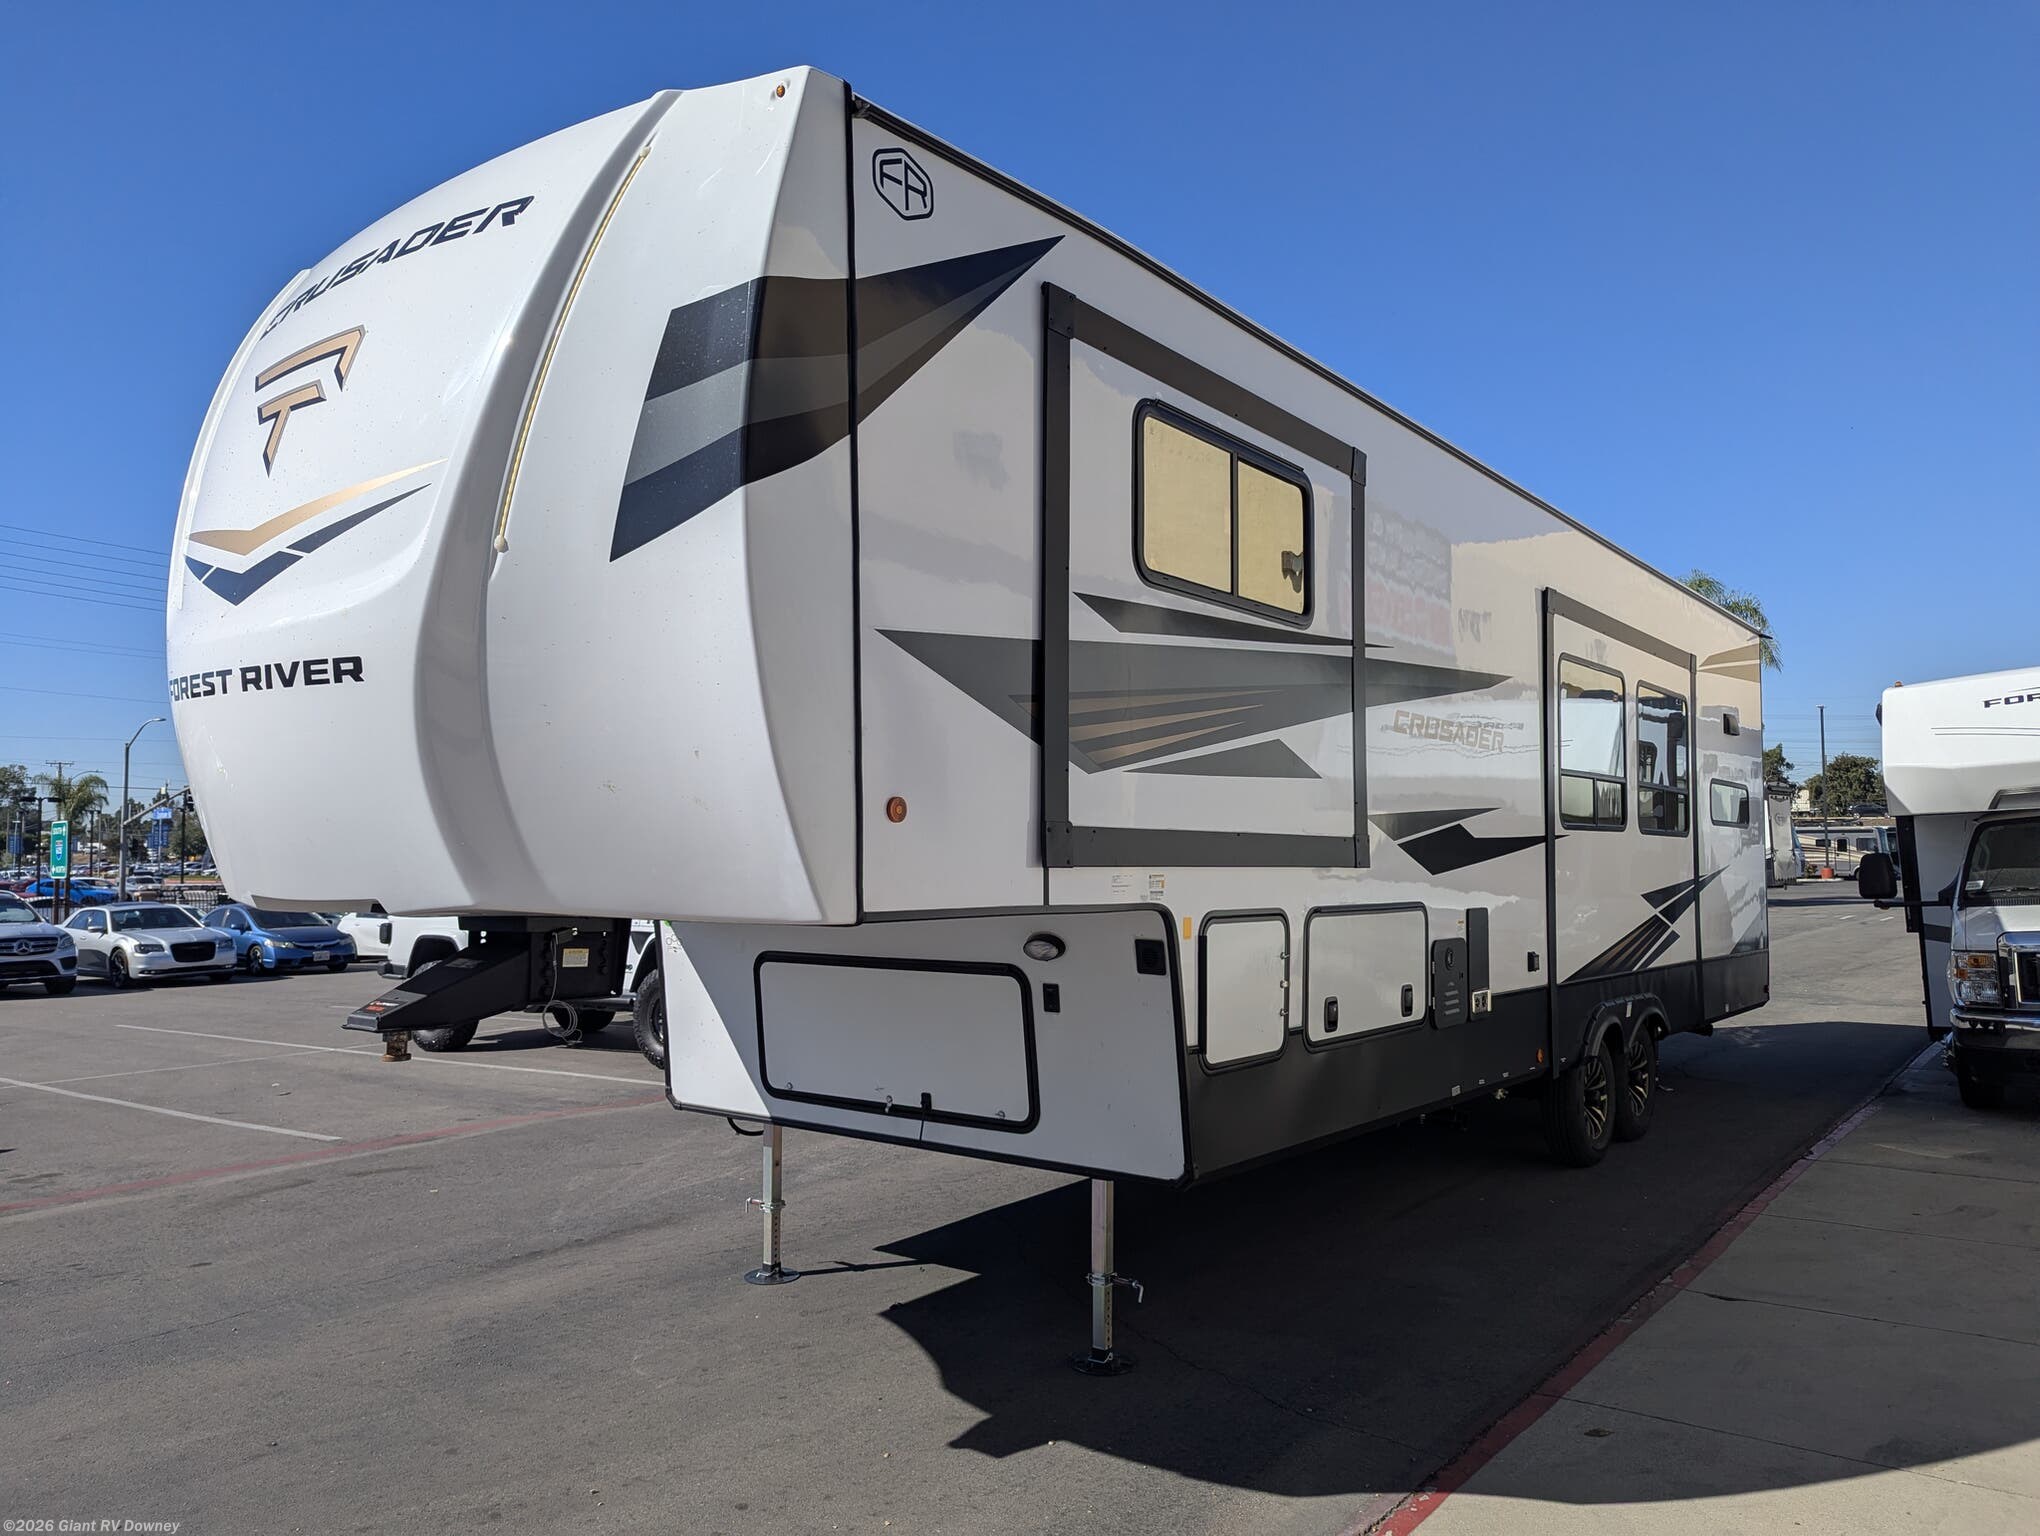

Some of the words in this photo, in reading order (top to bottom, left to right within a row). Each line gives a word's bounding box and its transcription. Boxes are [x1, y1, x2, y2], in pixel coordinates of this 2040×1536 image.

[259, 195, 535, 341] CRUSADER
[169, 668, 233, 701] FOREST
[239, 655, 365, 692] RIVER
[1393, 709, 1504, 752] CRUSADER
